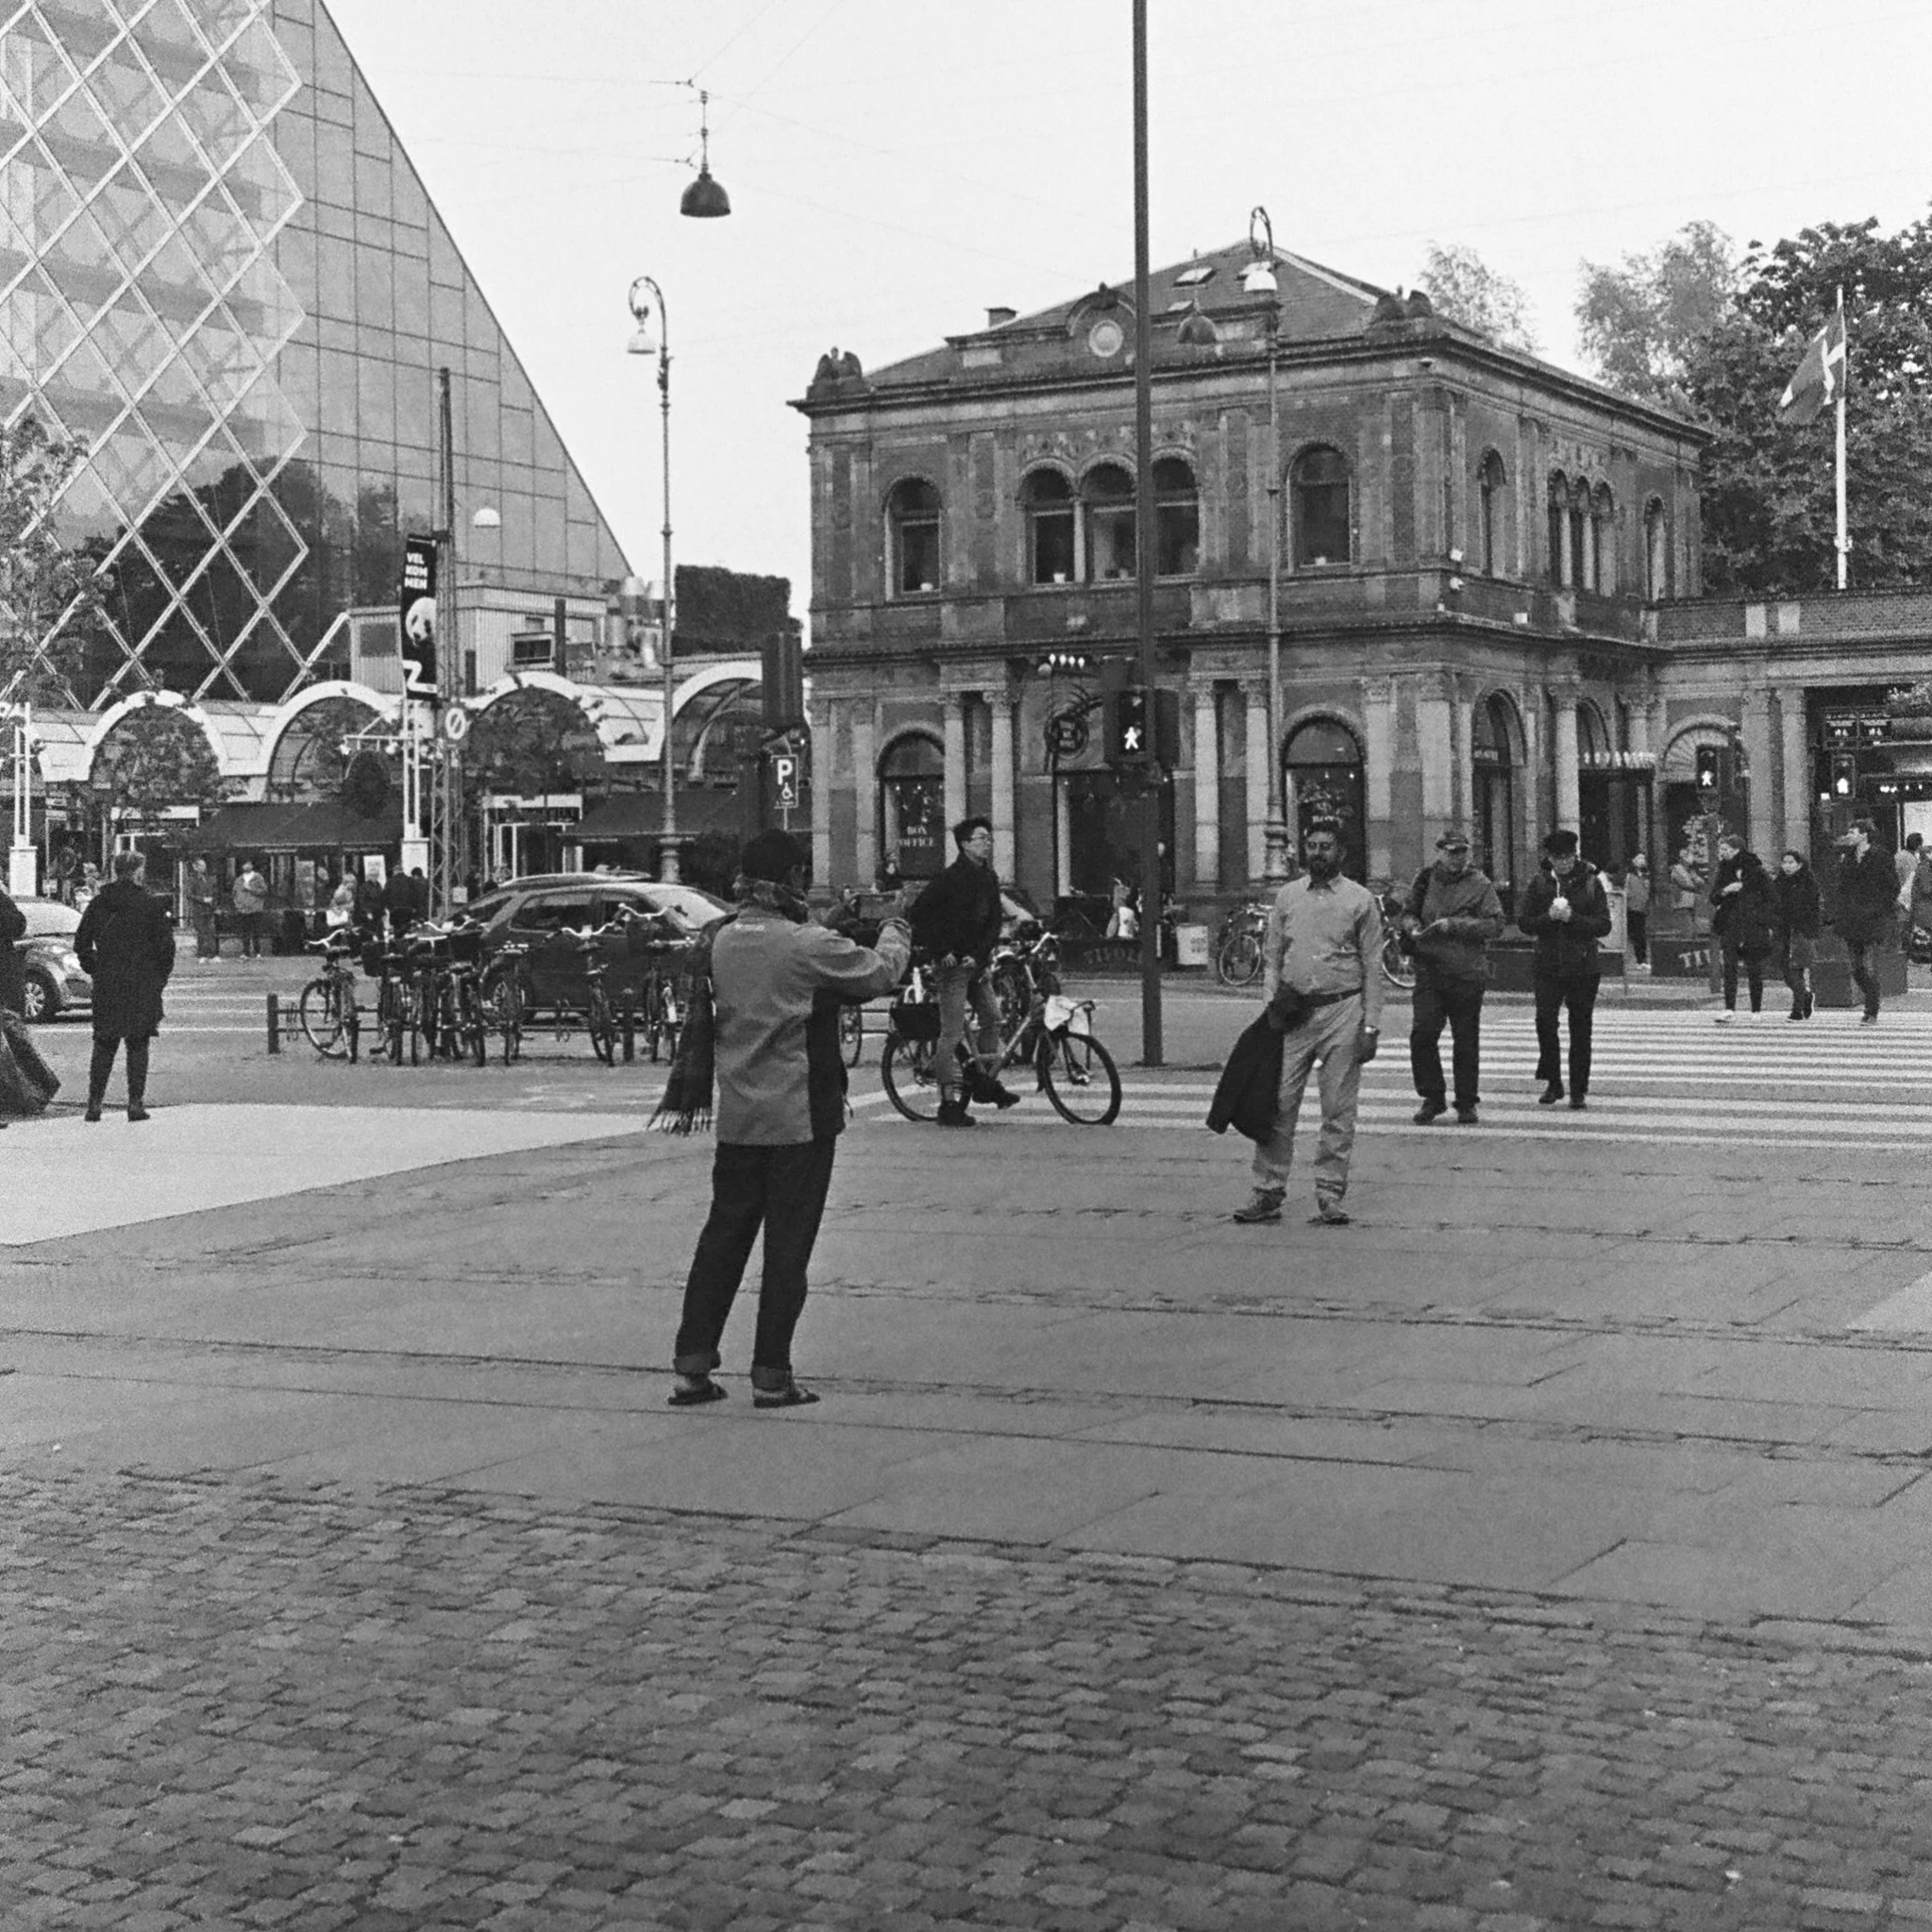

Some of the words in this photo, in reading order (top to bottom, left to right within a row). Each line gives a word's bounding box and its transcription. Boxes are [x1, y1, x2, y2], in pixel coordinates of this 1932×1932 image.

[406, 552, 424, 564] VEL
[406, 564, 428, 577] KOM
[404, 577, 428, 590] MEN
[777, 759, 793, 785] P
[907, 826, 927, 835] BOX
